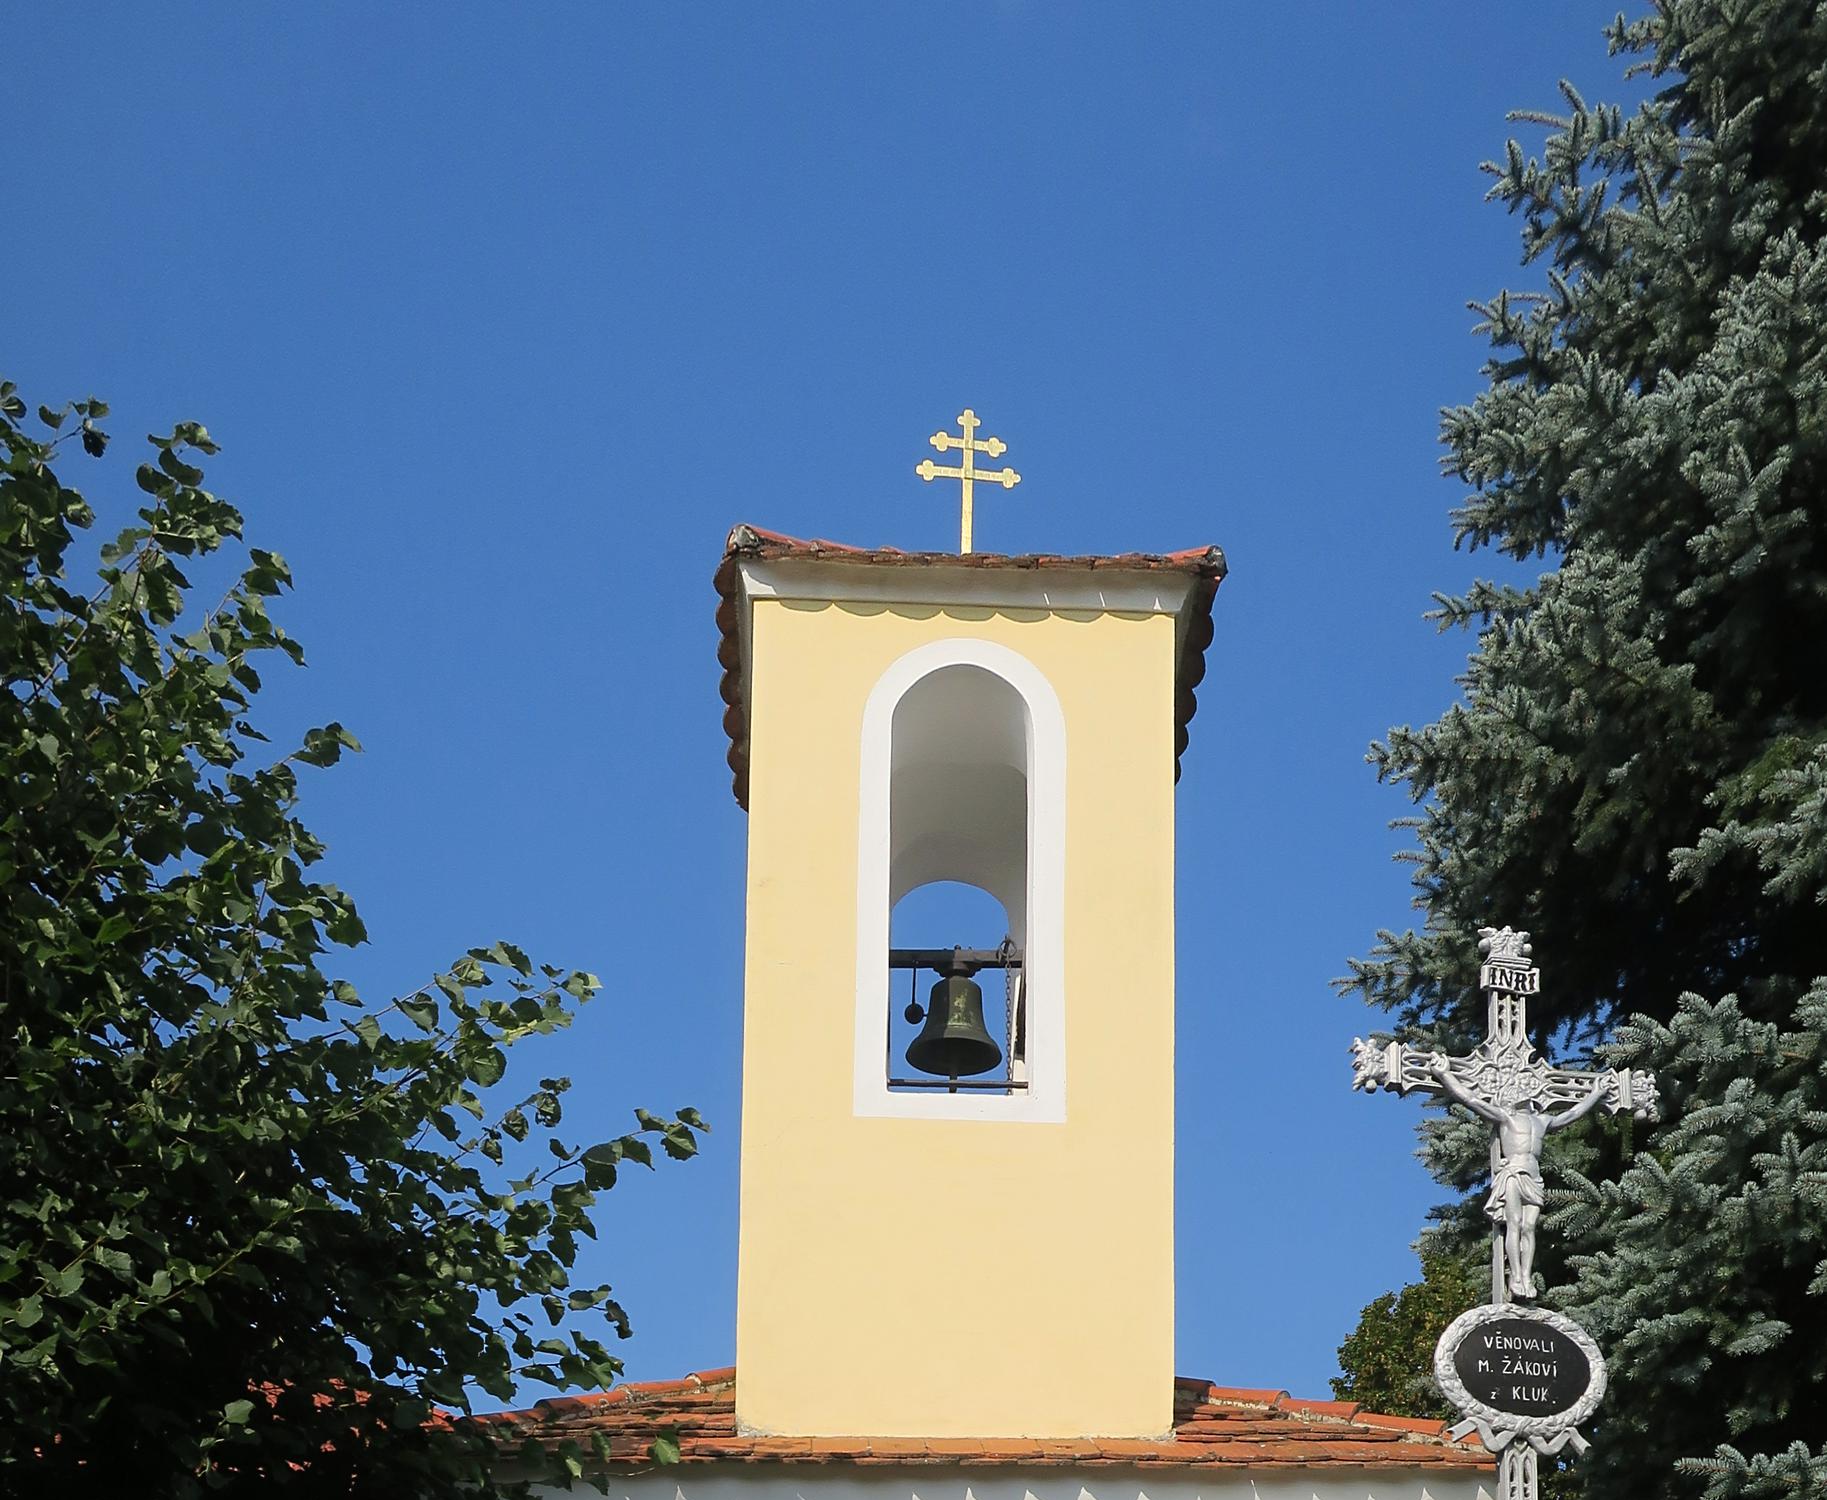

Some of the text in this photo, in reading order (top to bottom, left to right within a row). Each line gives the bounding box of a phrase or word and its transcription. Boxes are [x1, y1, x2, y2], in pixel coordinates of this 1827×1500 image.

[1489, 967, 1536, 991] INRI
[1484, 1331, 1554, 1353] VĚNOVALI
[1478, 1359, 1493, 1372] M.
